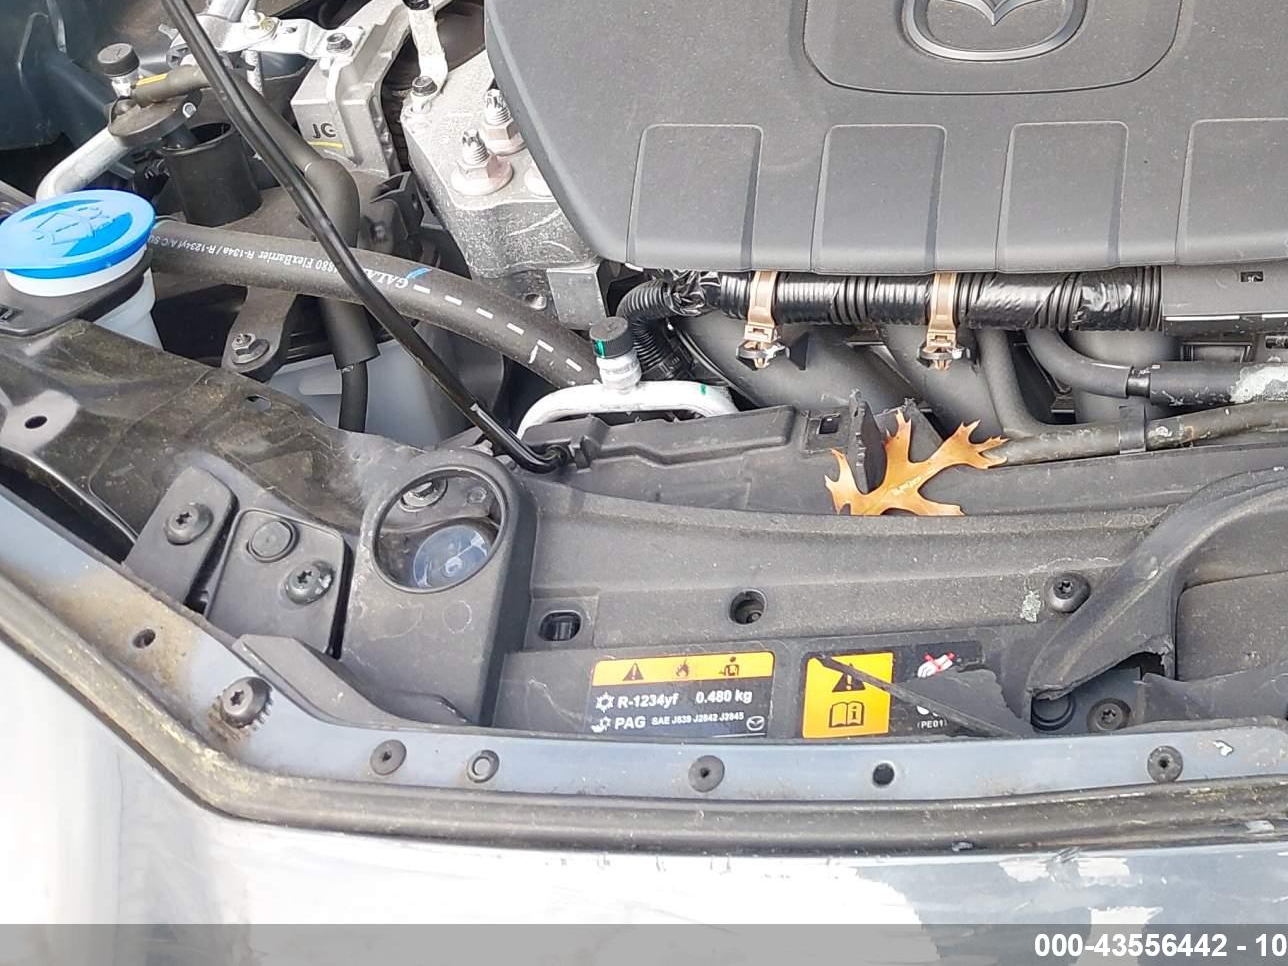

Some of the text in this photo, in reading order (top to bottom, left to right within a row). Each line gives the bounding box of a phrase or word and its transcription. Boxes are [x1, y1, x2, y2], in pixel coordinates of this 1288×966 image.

[222, 246, 255, 259] R-134a
[257, 249, 315, 269] FlexBarrier
[362, 267, 410, 289] GALA
[617, 689, 753, 709] R-1234yf 0.480 kg
[614, 715, 646, 730] PAG
[651, 716, 670, 726] SAE
